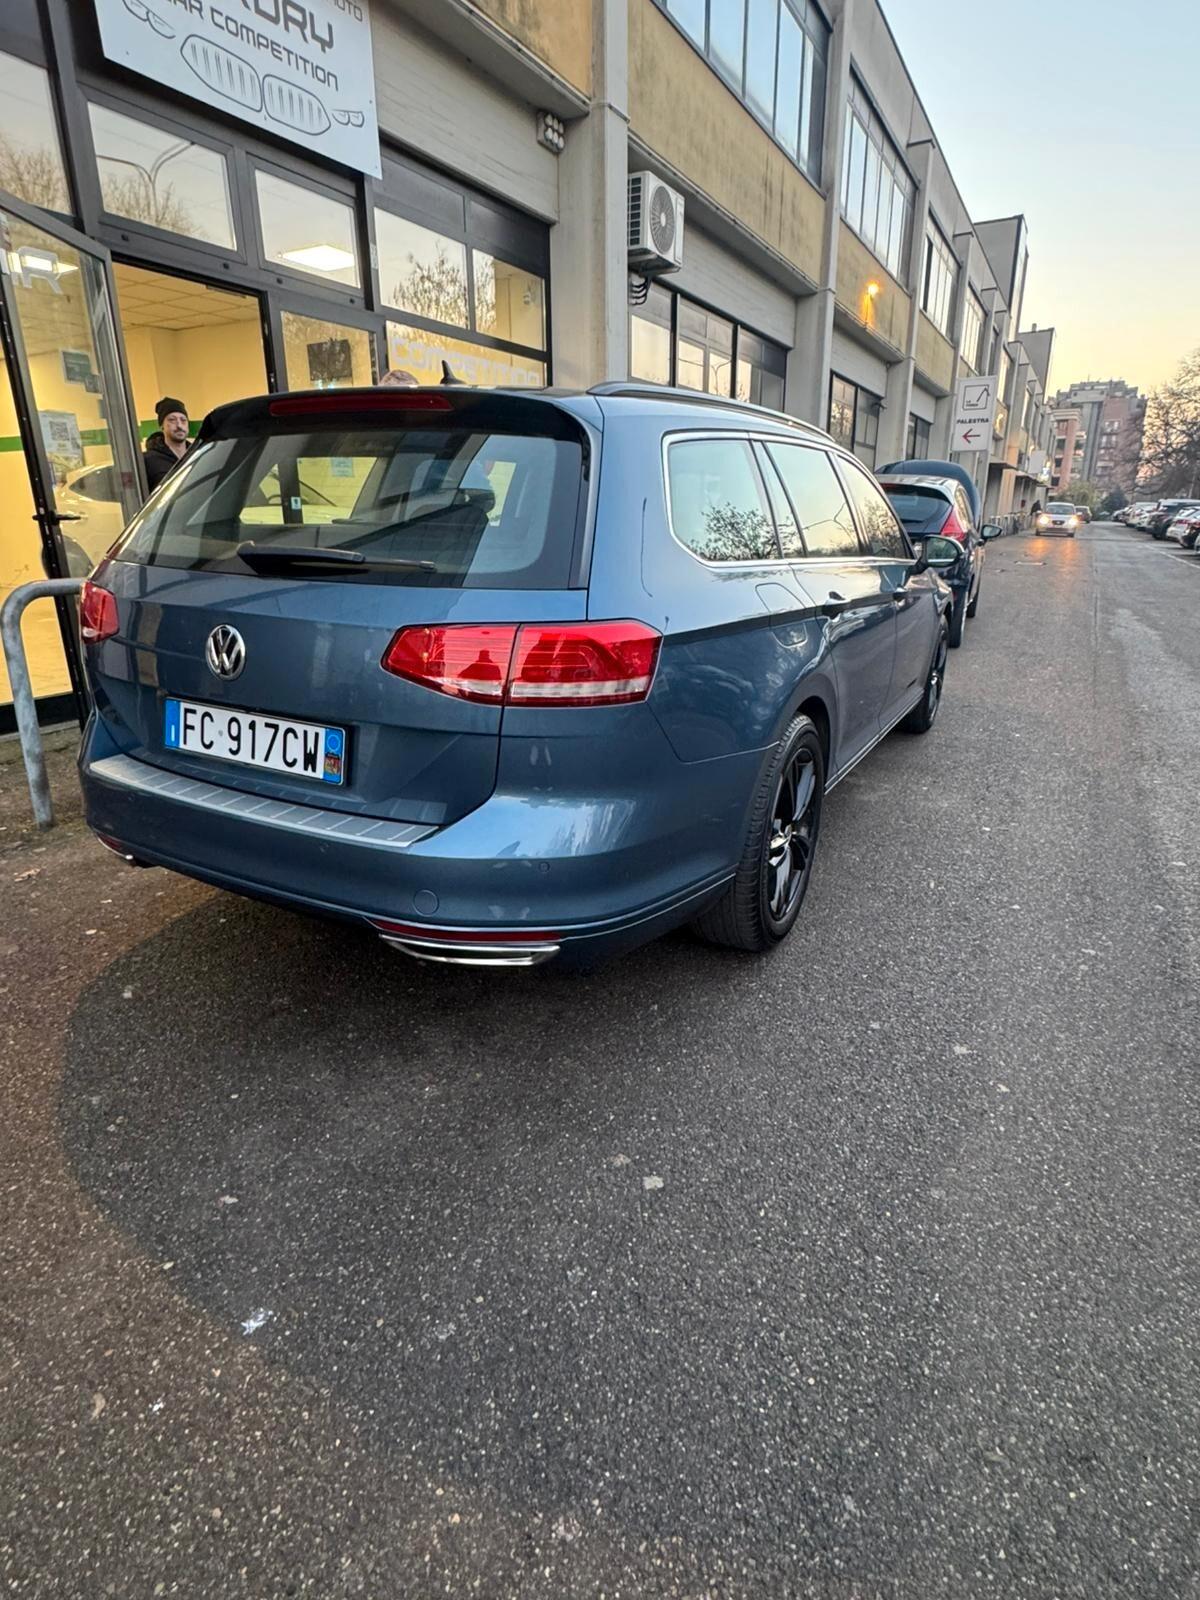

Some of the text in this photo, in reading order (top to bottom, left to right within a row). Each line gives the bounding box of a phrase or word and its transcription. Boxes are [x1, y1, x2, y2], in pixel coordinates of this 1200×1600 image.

[210, 6, 339, 92] COMPETITION
[183, 707, 320, 773] FC 917CW
